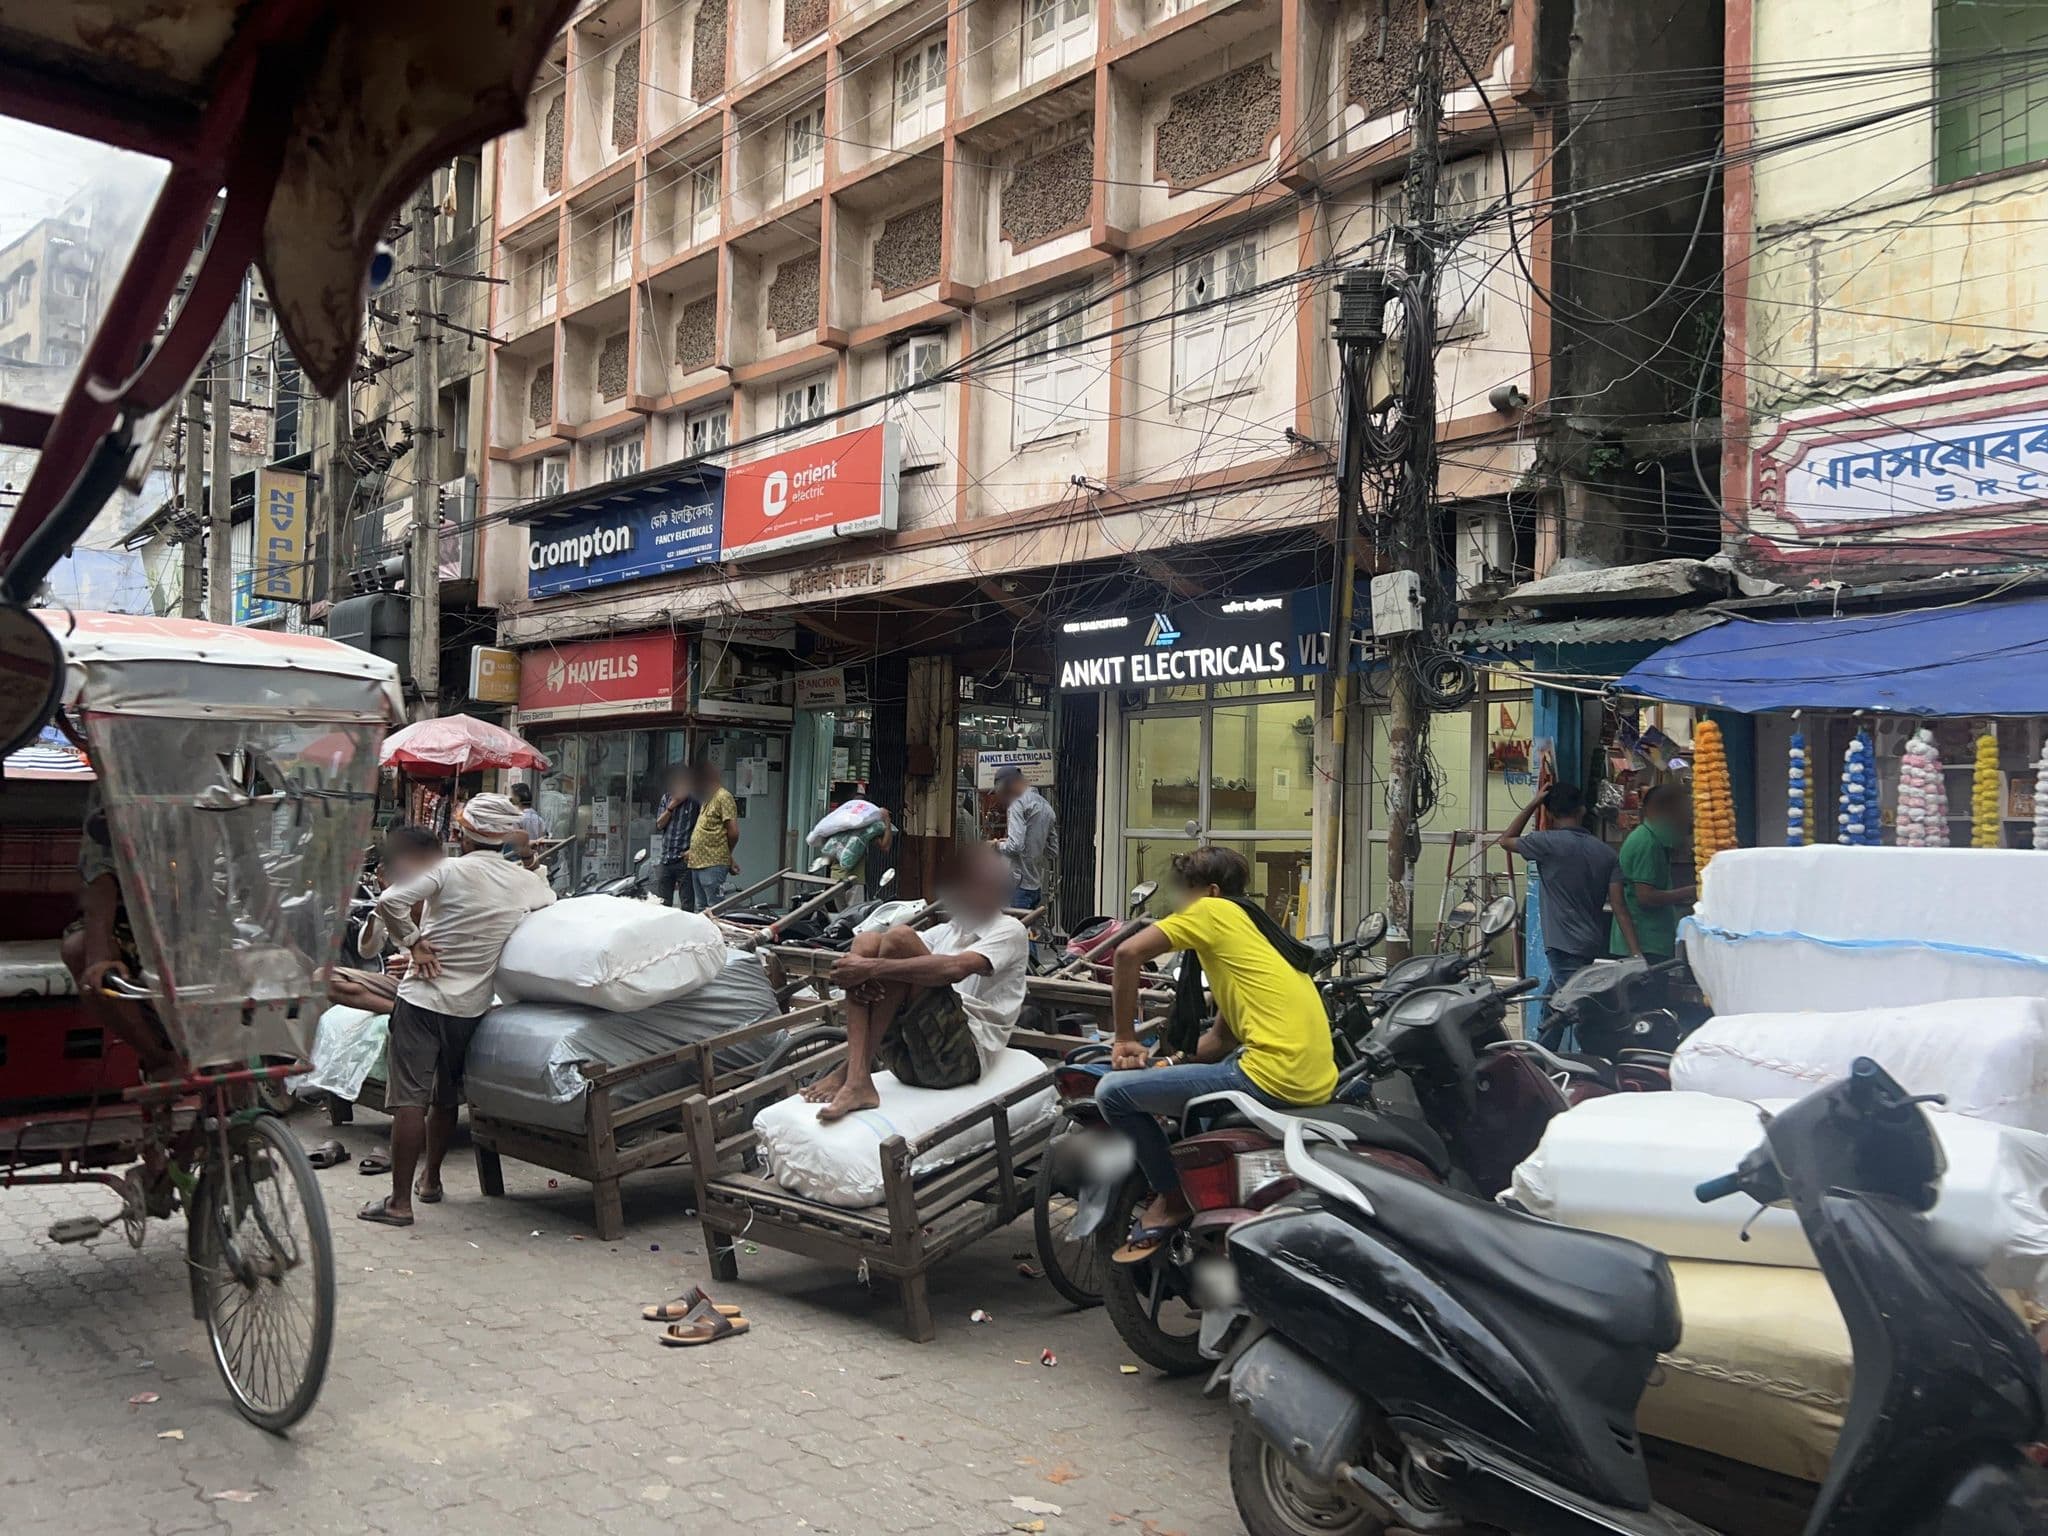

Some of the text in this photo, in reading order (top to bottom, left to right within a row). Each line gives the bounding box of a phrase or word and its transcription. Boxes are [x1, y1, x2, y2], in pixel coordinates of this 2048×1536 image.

[793, 459, 838, 489] orient
[792, 484, 825, 503] electric
[271, 488, 295, 532] NAV
[529, 524, 631, 571] Crompton
[655, 524, 713, 546] FANCY ELECTRICALS
[568, 654, 639, 685] HAVELLS
[1060, 641, 1286, 688] ANKIT ELECTRICALS
[806, 675, 842, 690] ANCHOR
[979, 752, 1052, 763] ANKIT ELECTRICALS
